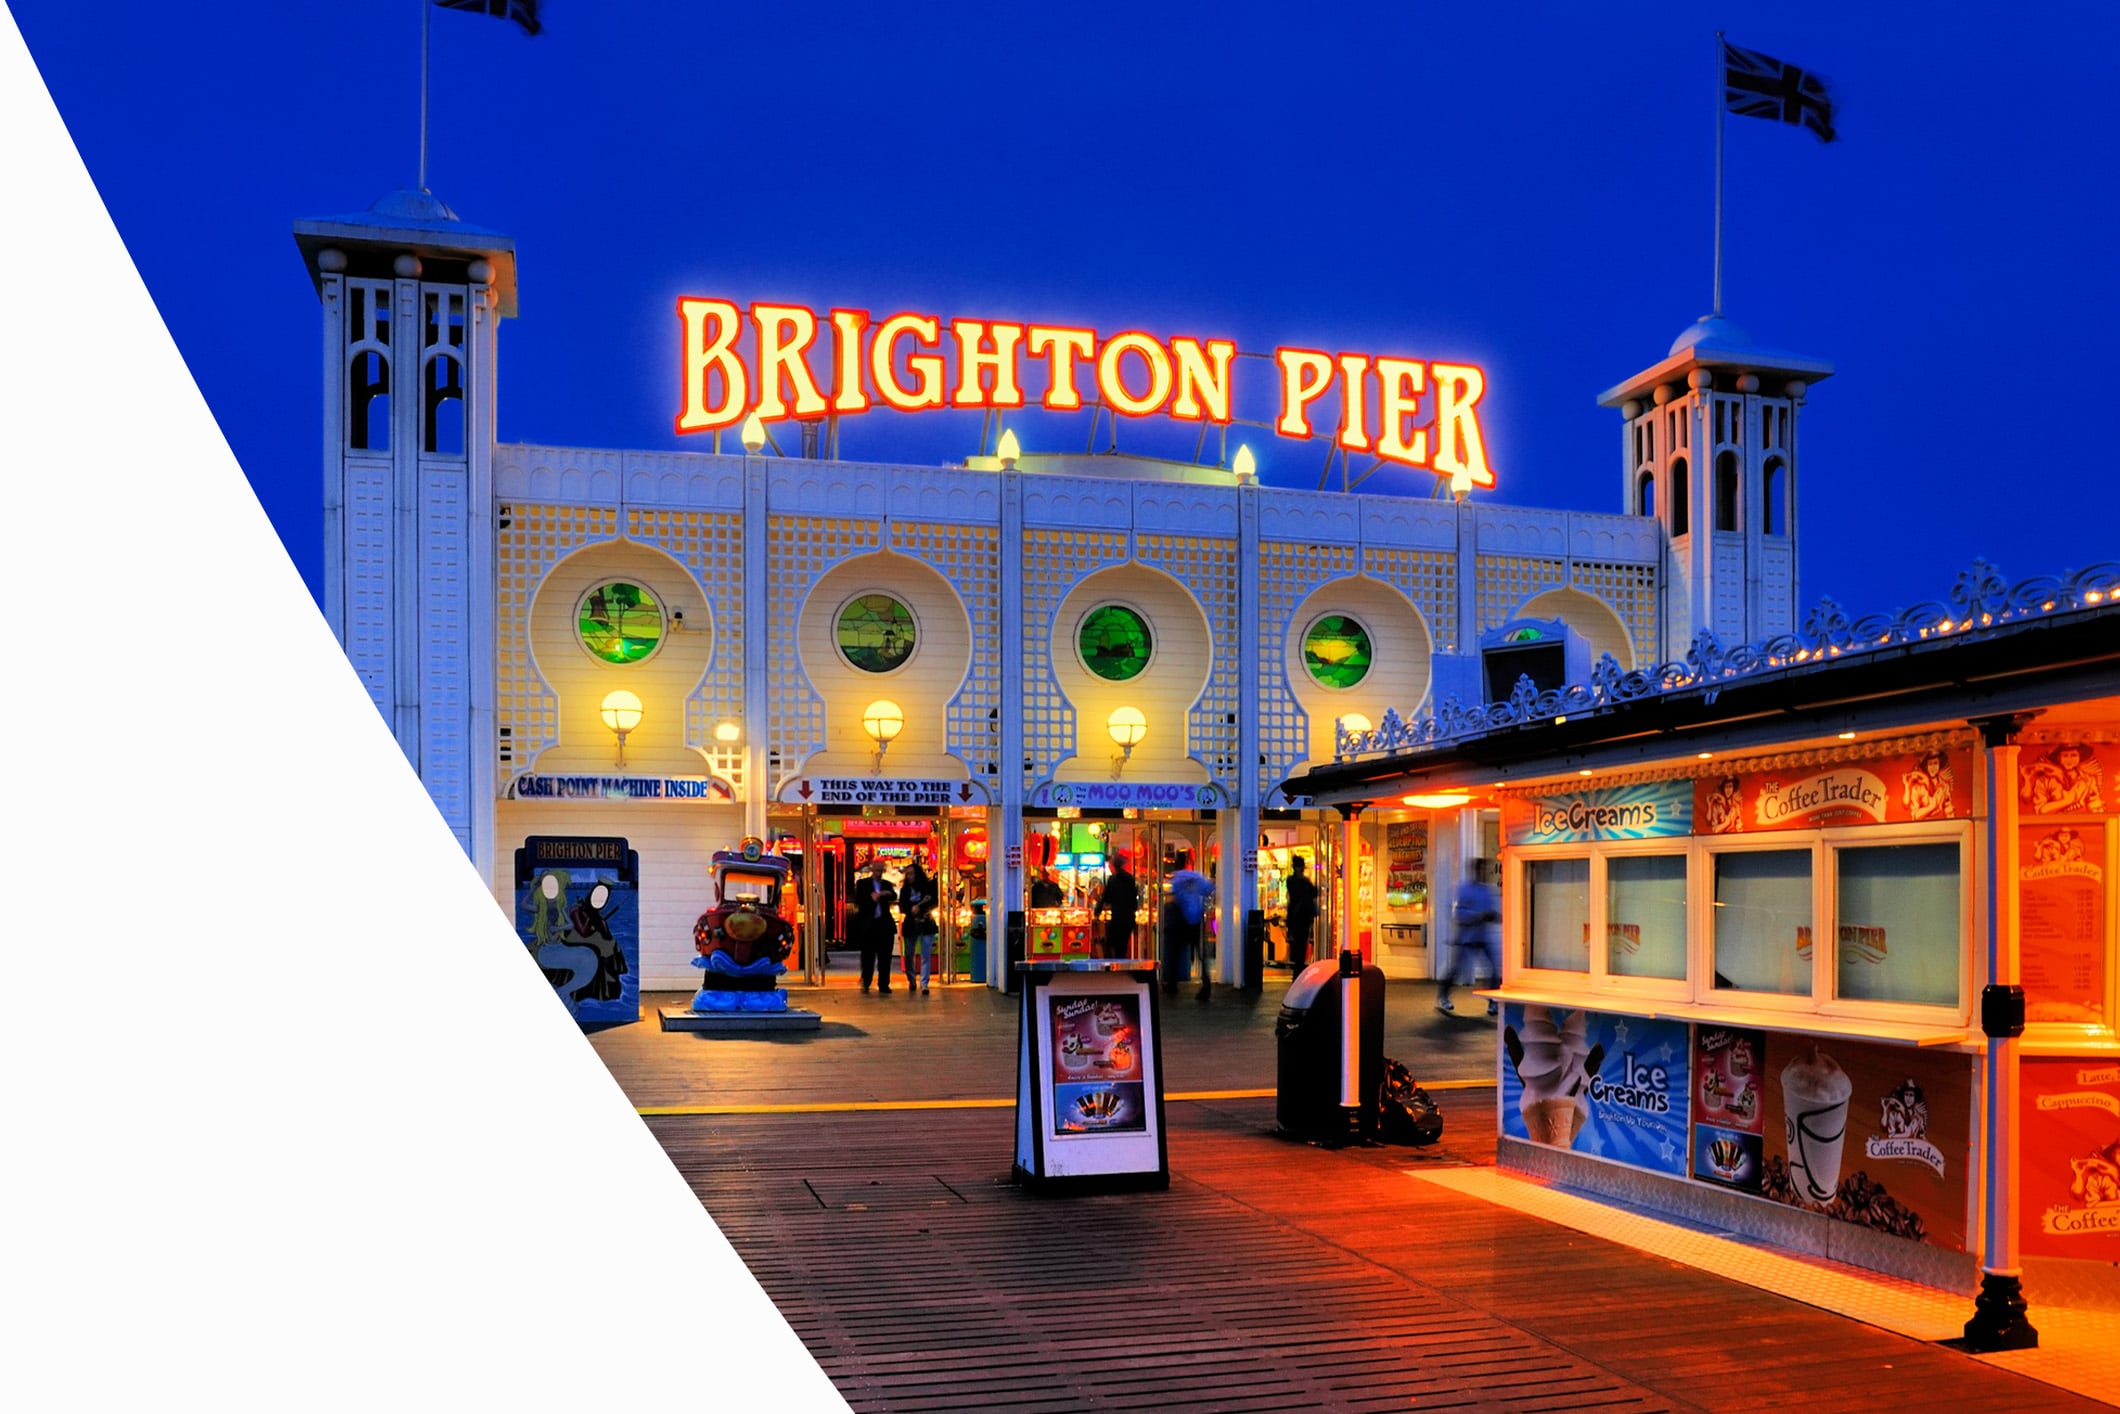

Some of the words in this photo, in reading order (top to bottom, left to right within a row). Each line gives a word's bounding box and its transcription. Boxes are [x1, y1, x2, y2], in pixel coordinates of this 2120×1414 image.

[674, 295, 1237, 434] BRIGHTON
[1276, 346, 1498, 489] PIER
[517, 776, 551, 796] CASH
[557, 777, 598, 797] POINT
[601, 777, 660, 797] MACHINE
[664, 778, 708, 798] INSIDE
[820, 780, 857, 790] THIS
[861, 780, 894, 791] WAY
[897, 781, 918, 791] TO
[921, 782, 950, 792] THE
[1088, 784, 1131, 800] MOO
[1136, 785, 1195, 801] MOO'S
[1765, 782, 1779, 793] THE
[821, 791, 853, 801] END
[860, 792, 877, 802] OF
[880, 792, 910, 803] THE
[914, 793, 950, 803] PIER
[1764, 785, 1819, 820] Coffee
[1818, 776, 1881, 809] Trader
[537, 842, 593, 859] BRIGHTON
[597, 843, 622, 860] PIER
[2024, 866, 2060, 879] Coffee
[2062, 864, 2100, 878] Trader
[1624, 1051, 1669, 1090] Ice
[2082, 1071, 2115, 1083] Latte,
[1589, 1075, 1669, 1113] Creams
[2041, 1094, 2111, 1110] Cappuccino
[1870, 1141, 1905, 1157] Coffee
[1903, 1140, 1943, 1167] Trader
[2053, 1204, 2070, 1213] THE
[2051, 1211, 2119, 1232] Coffee
